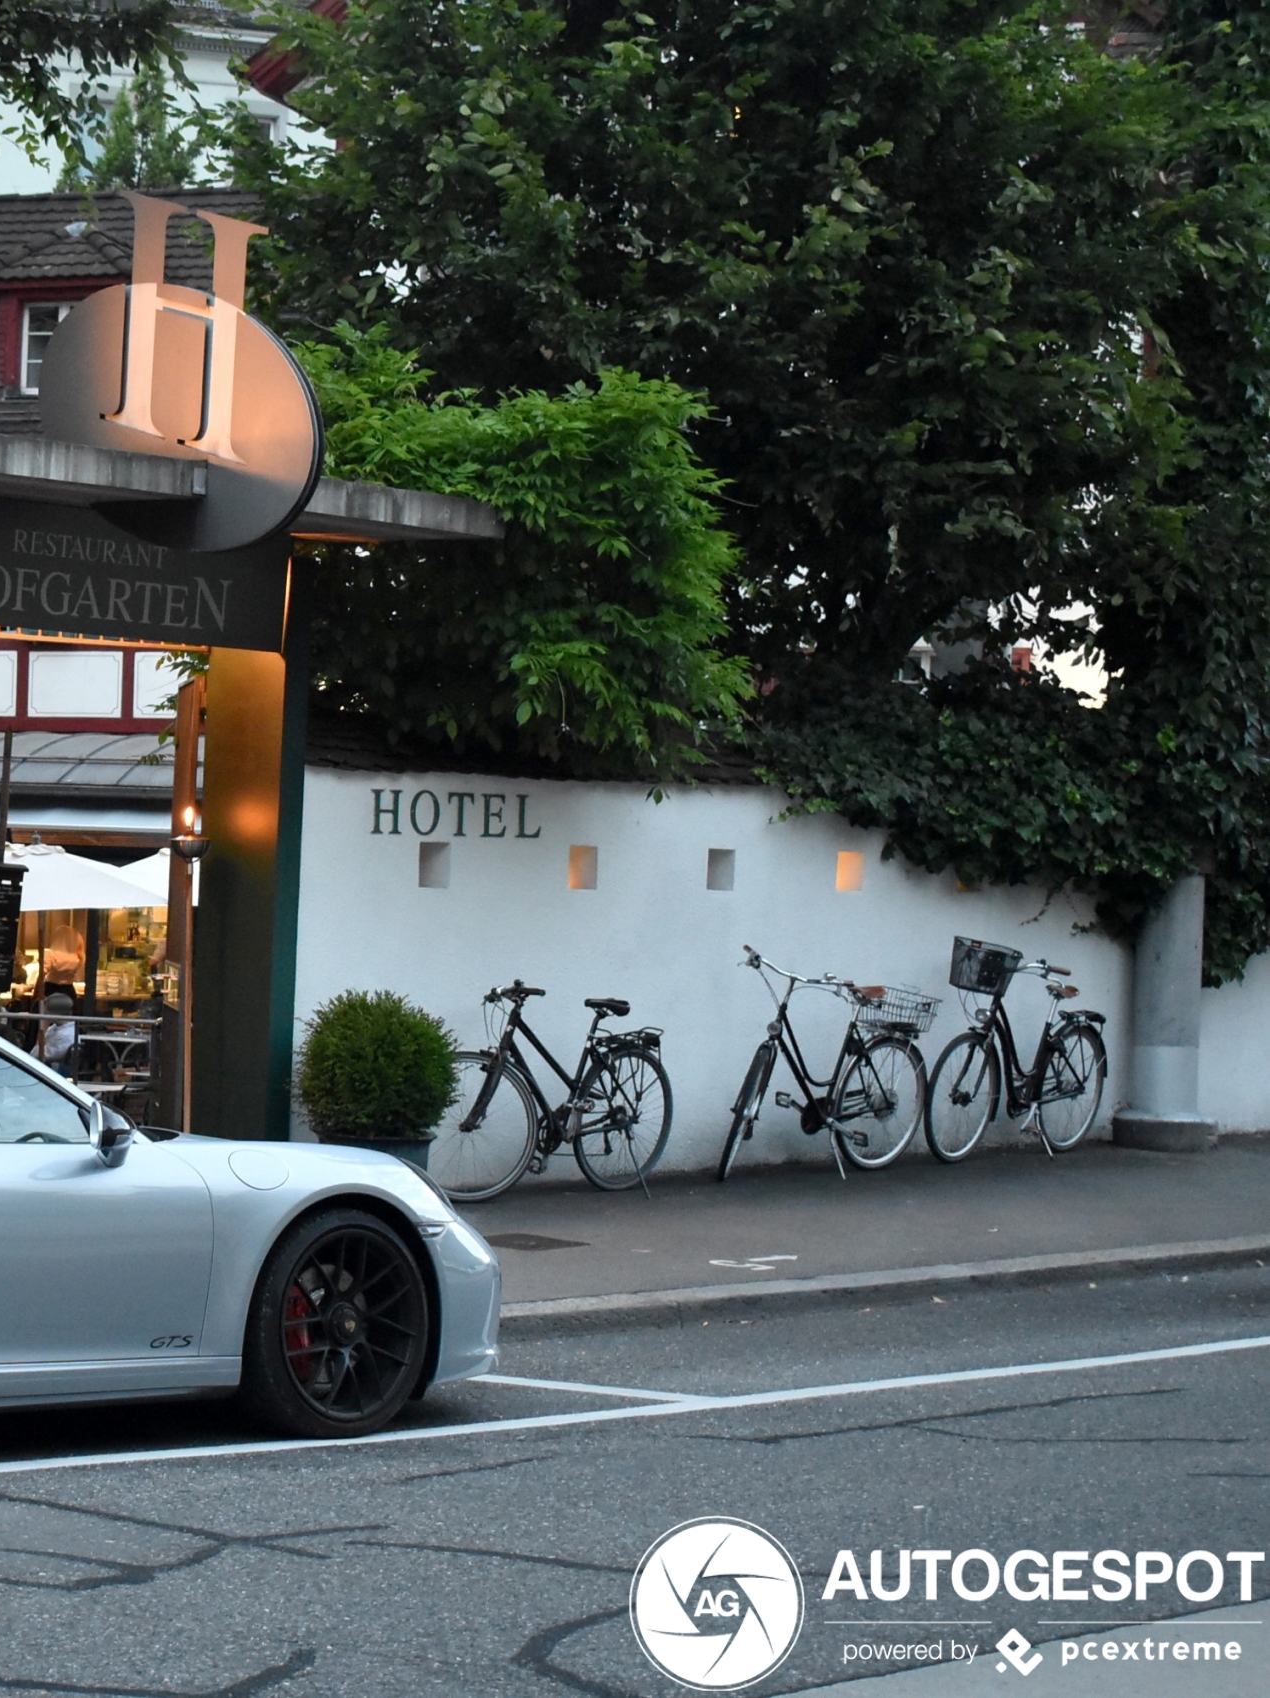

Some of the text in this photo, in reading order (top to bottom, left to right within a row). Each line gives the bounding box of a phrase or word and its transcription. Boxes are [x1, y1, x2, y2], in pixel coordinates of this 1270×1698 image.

[14, 529, 168, 569] RESTAURANT
[370, 789, 542, 838] HOTEL
[150, 1335, 194, 1349] GTS
